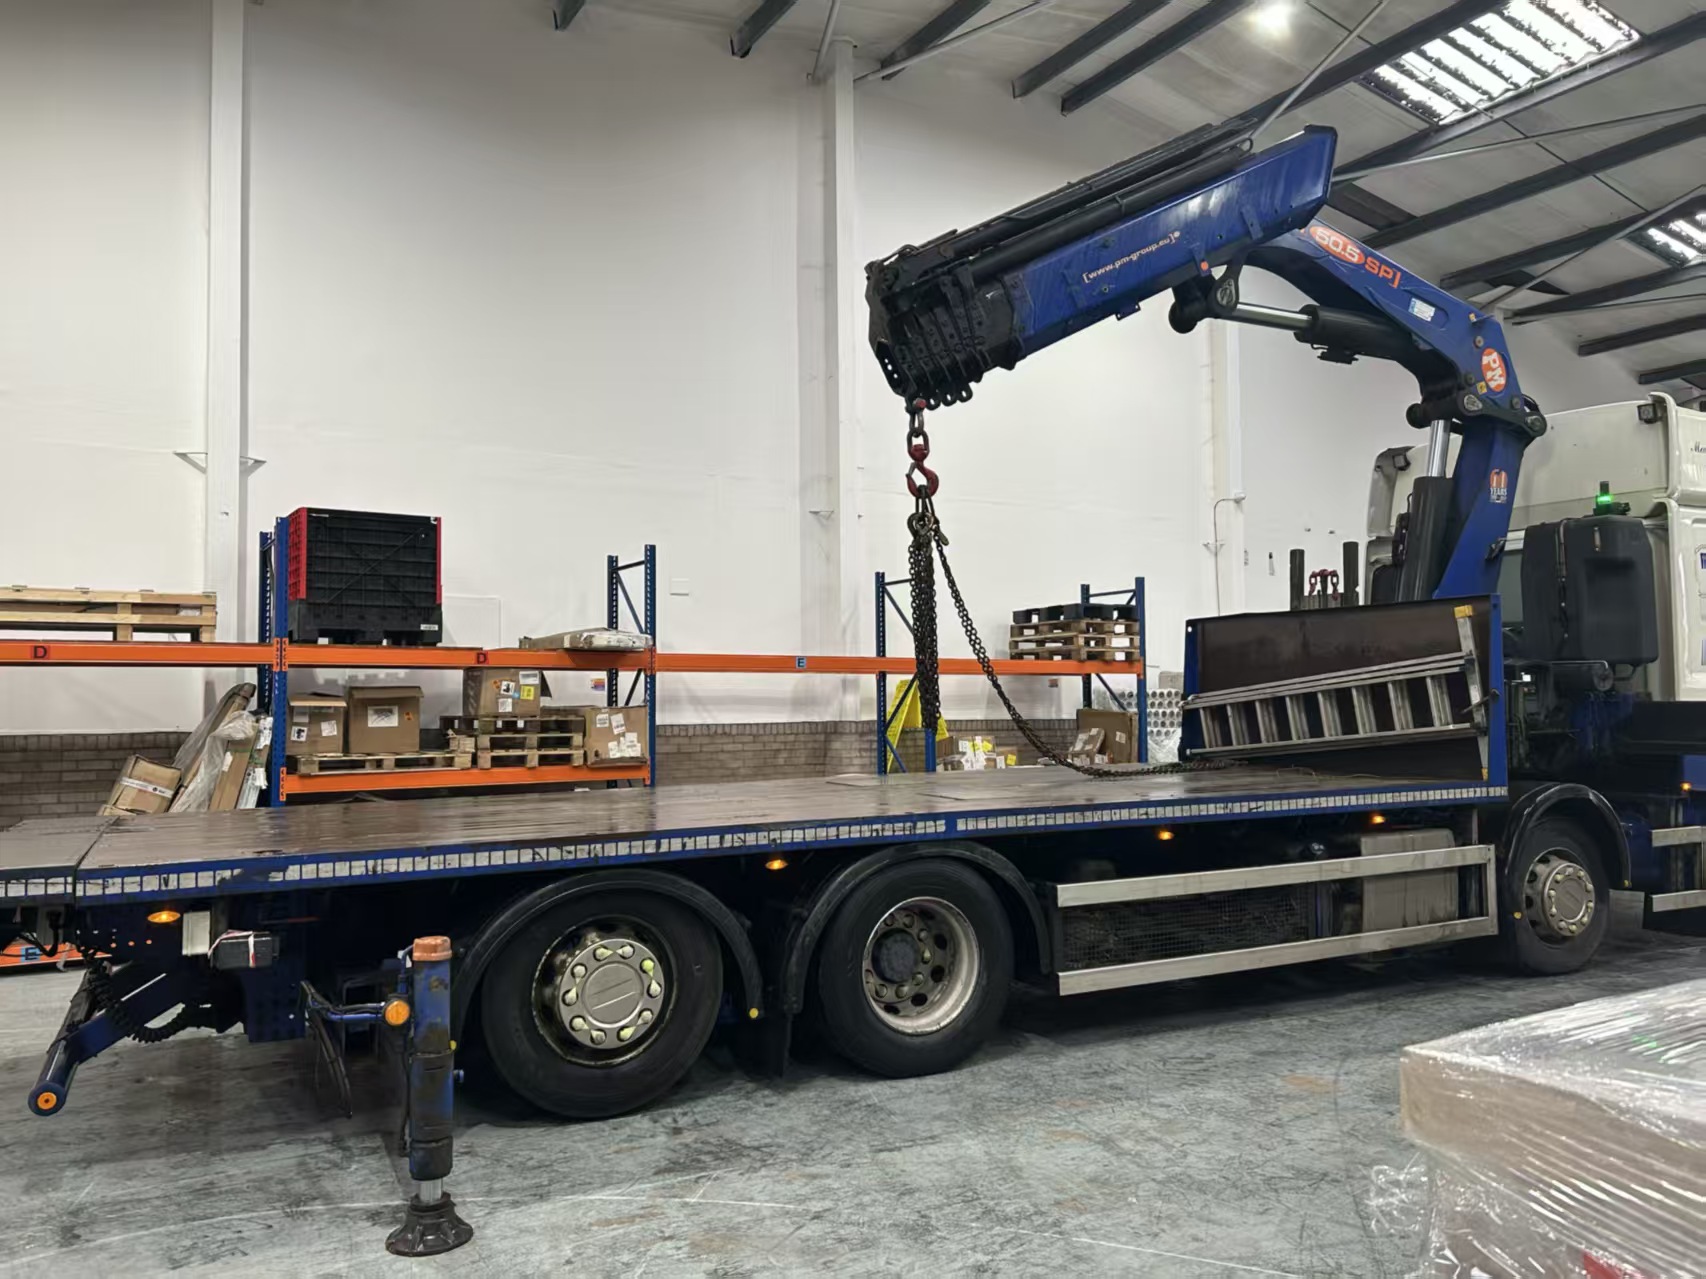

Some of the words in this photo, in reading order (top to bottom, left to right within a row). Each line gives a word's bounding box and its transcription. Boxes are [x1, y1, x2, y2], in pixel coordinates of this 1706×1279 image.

[1481, 351, 1506, 389] PM
[33, 645, 48, 659] D
[476, 652, 487, 665] D
[797, 657, 805, 668] E
